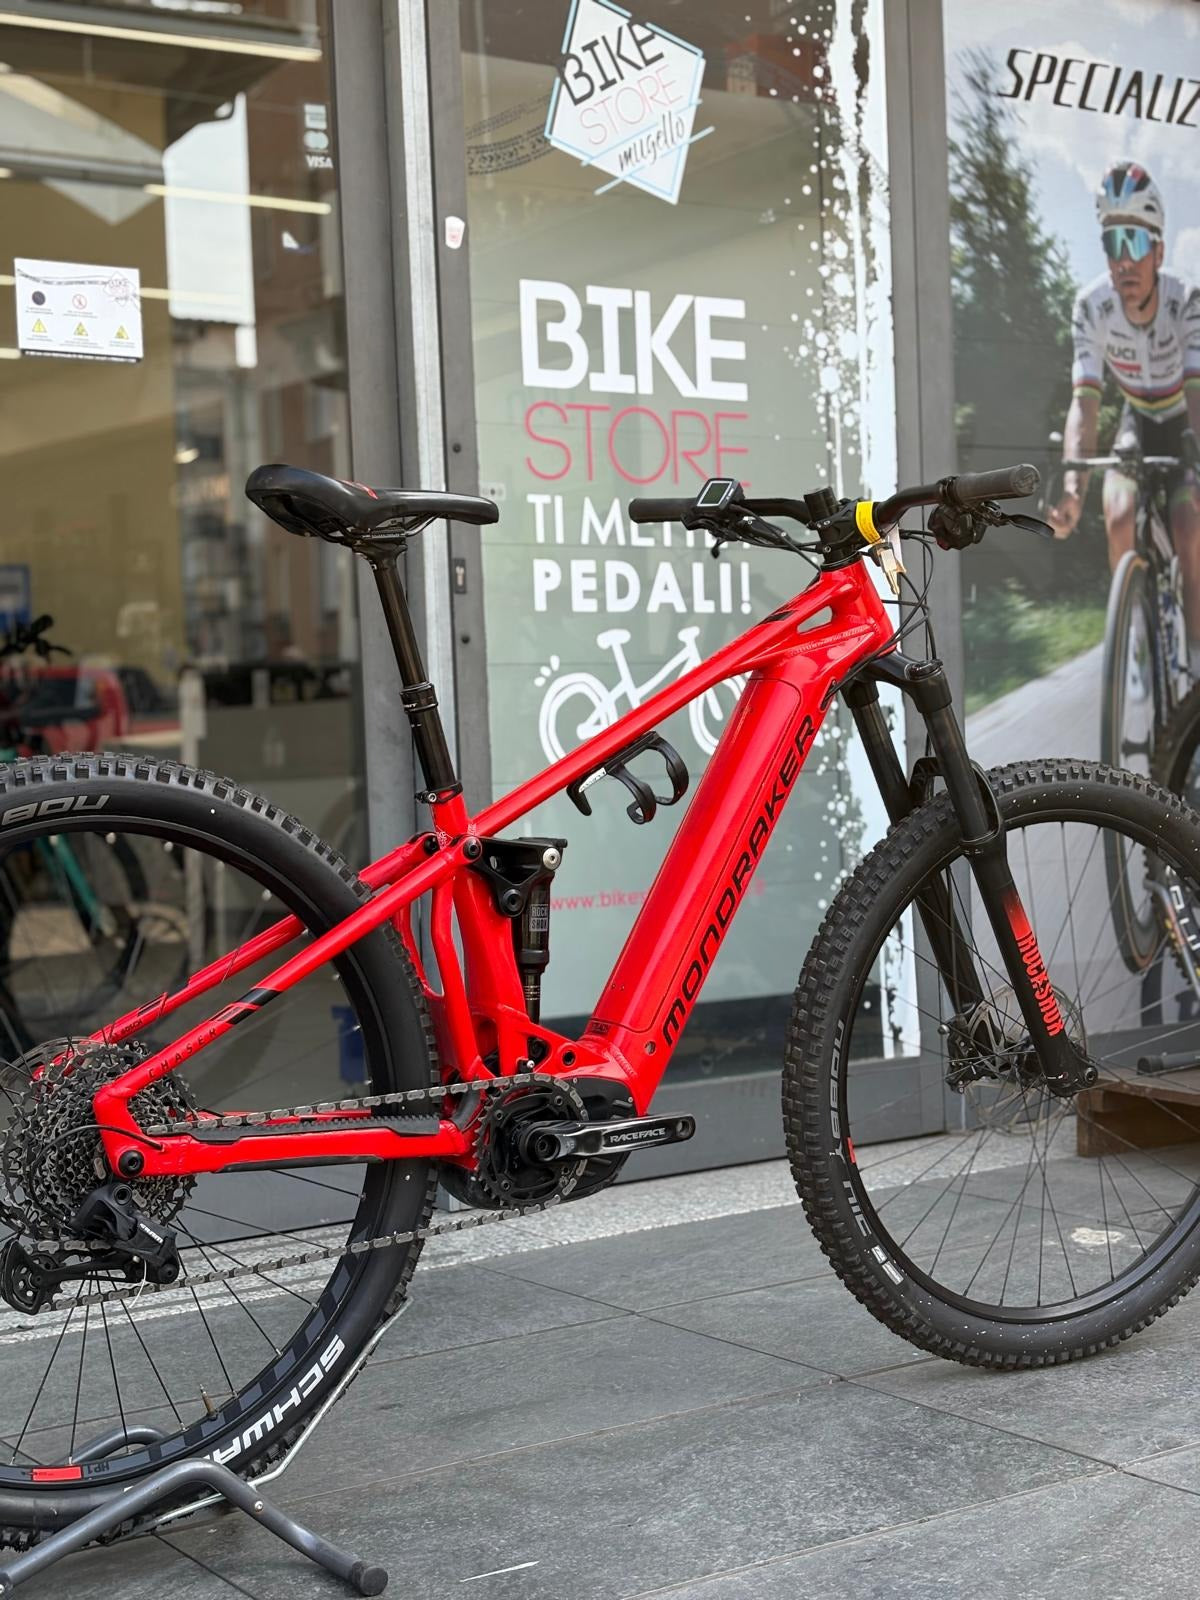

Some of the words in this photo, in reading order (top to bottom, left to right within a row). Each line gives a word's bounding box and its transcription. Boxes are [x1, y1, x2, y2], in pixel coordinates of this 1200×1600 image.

[556, 17, 665, 106] BIKE
[579, 63, 684, 146] STORE
[305, 154, 334, 169] VISA
[519, 279, 748, 401] BIKE
[524, 402, 751, 487] STORE
[527, 494, 565, 544] TI
[532, 559, 752, 615] PEDALI!
[663, 714, 815, 1048] MONDRAKER
[148, 1027, 217, 1079] CHASER
[203, 1334, 346, 1466] SCHWA
